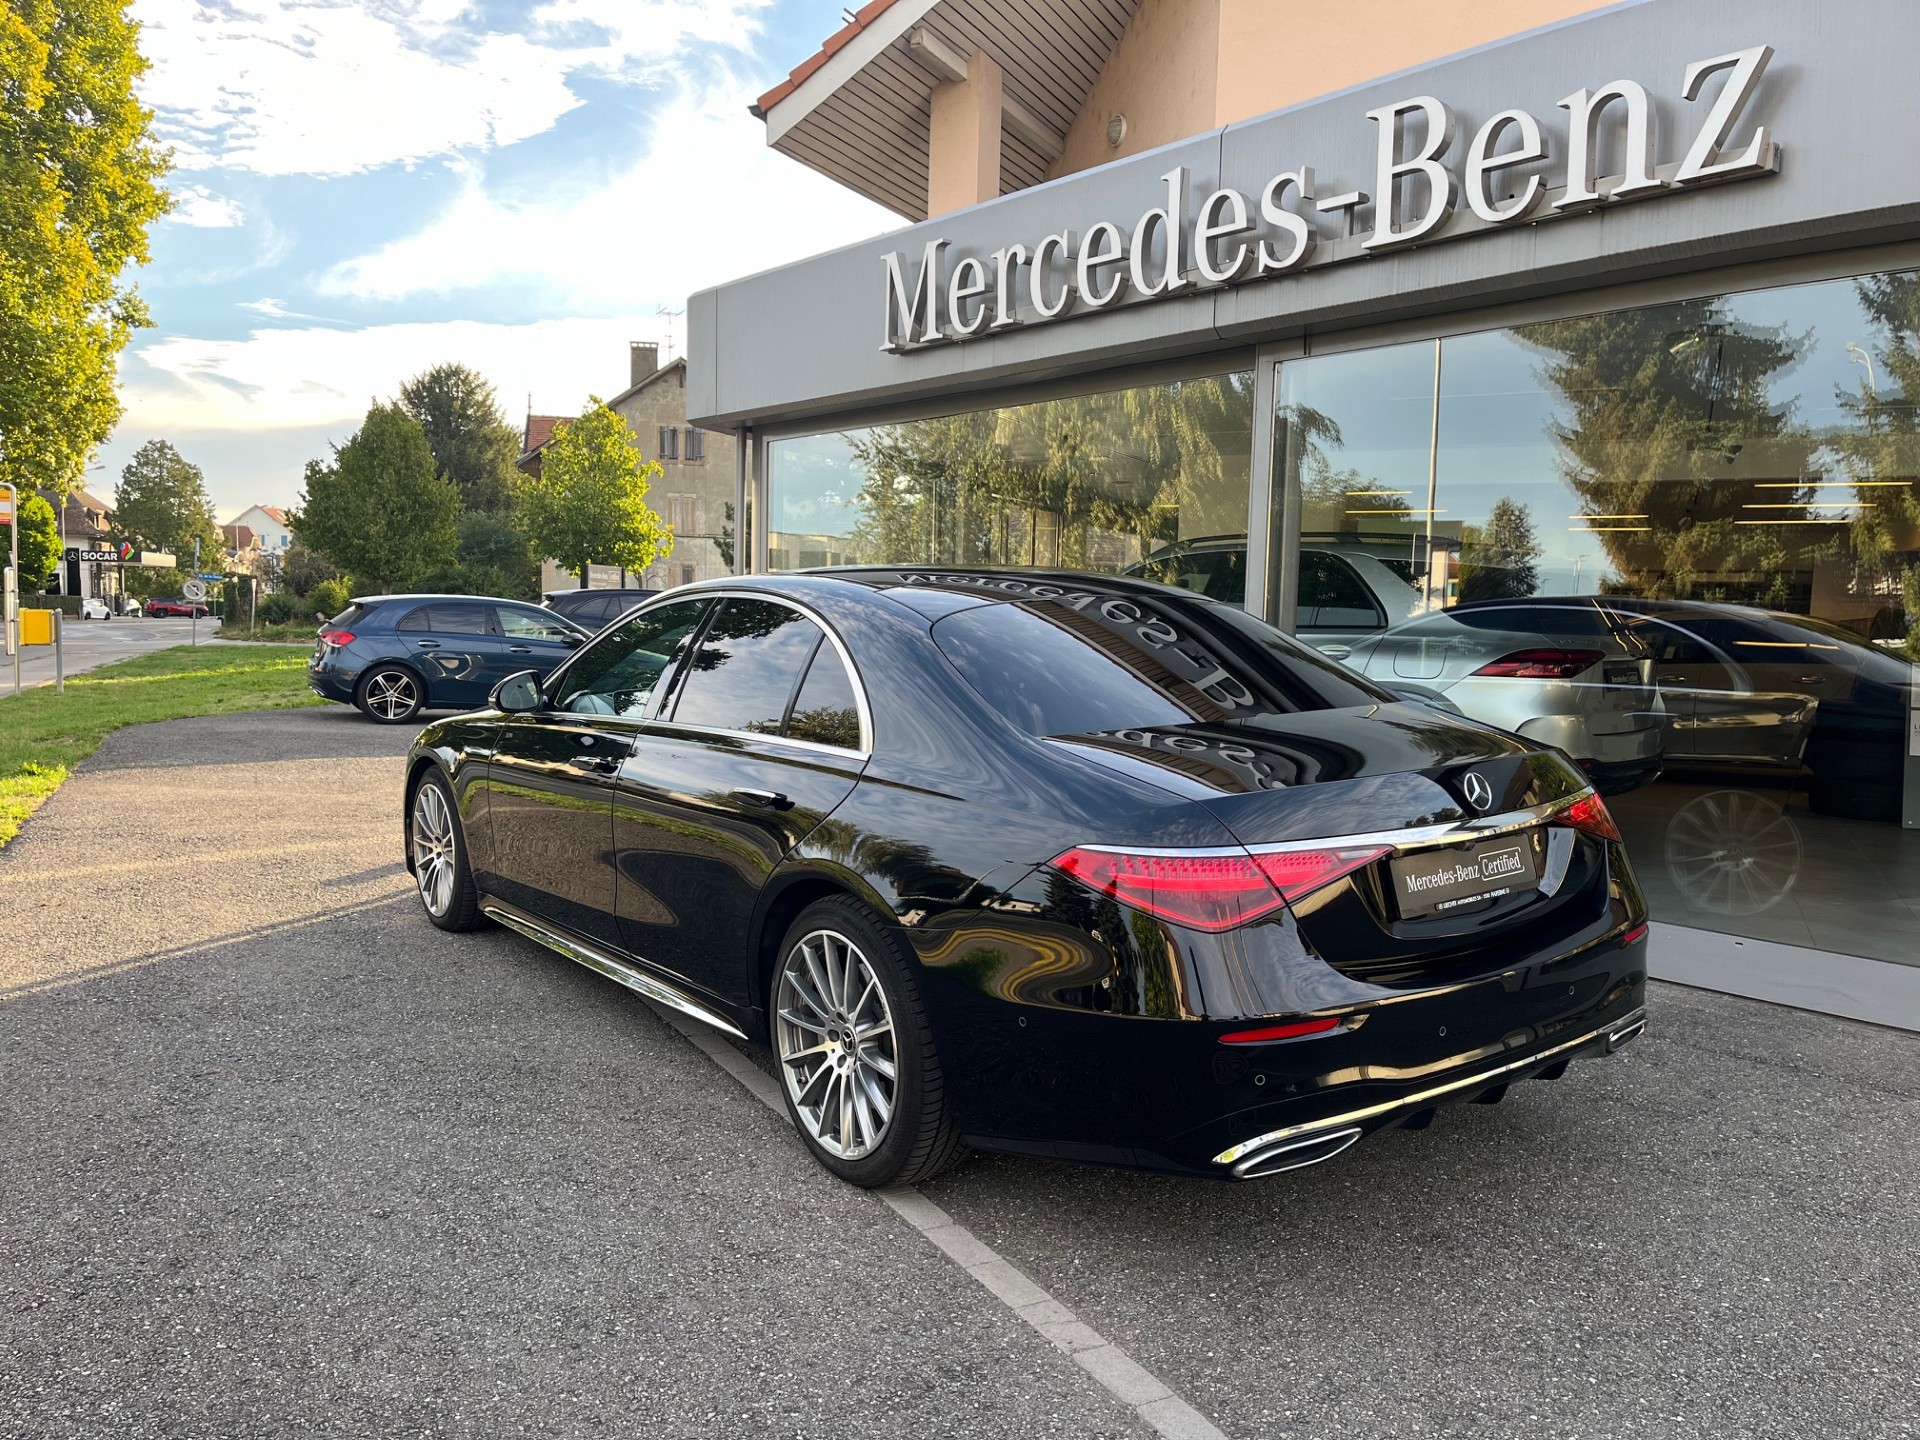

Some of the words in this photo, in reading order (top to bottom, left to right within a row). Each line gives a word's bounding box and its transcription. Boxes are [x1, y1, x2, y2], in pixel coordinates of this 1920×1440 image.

[879, 44, 1778, 353] Mercedes-Benz
[82, 552, 118, 561] SOCAR
[1405, 863, 1481, 893] Mercedes-Benz
[1482, 851, 1522, 876] Certified
